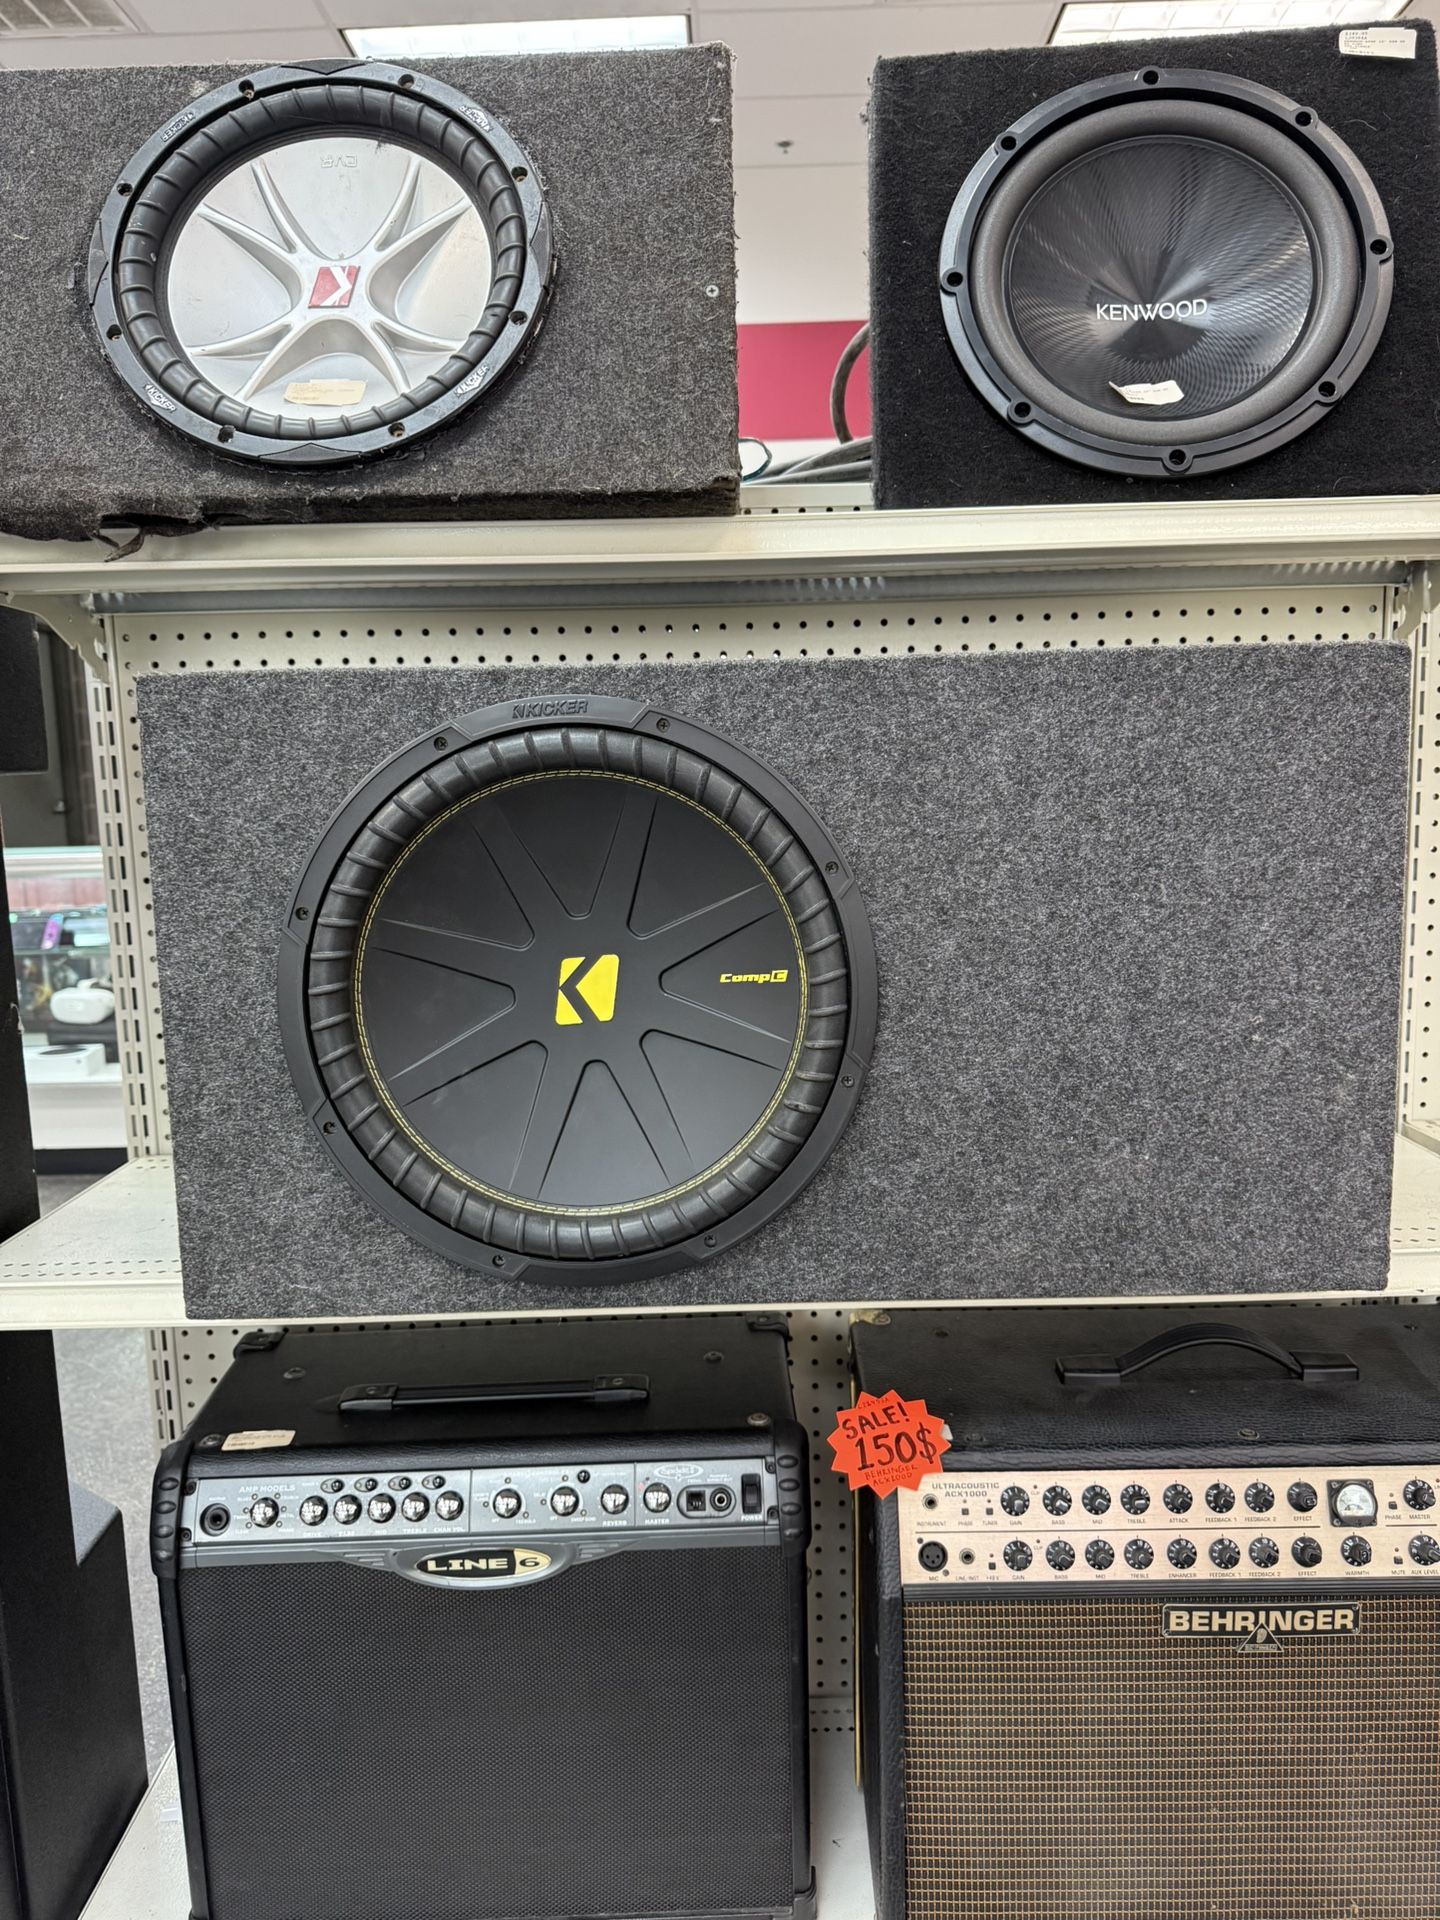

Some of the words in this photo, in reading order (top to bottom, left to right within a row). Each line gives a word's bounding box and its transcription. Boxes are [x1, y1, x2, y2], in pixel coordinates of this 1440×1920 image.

[160, 114, 191, 142] KICKER
[320, 154, 358, 169] CVR
[1096, 298, 1208, 321] KENWOOD
[458, 364, 490, 391] KICKER
[147, 386, 177, 413] KICKER
[523, 698, 589, 718] KICKER
[842, 1401, 910, 1440] SALE!
[855, 1422, 937, 1472] 150$
[864, 1464, 918, 1480] BEHRINGER
[932, 1482, 1000, 1490] ULTRACOUSTIC
[426, 1558, 508, 1572] LINE
[519, 1556, 540, 1568] 6
[1168, 1608, 1354, 1632] BEHRINGER
